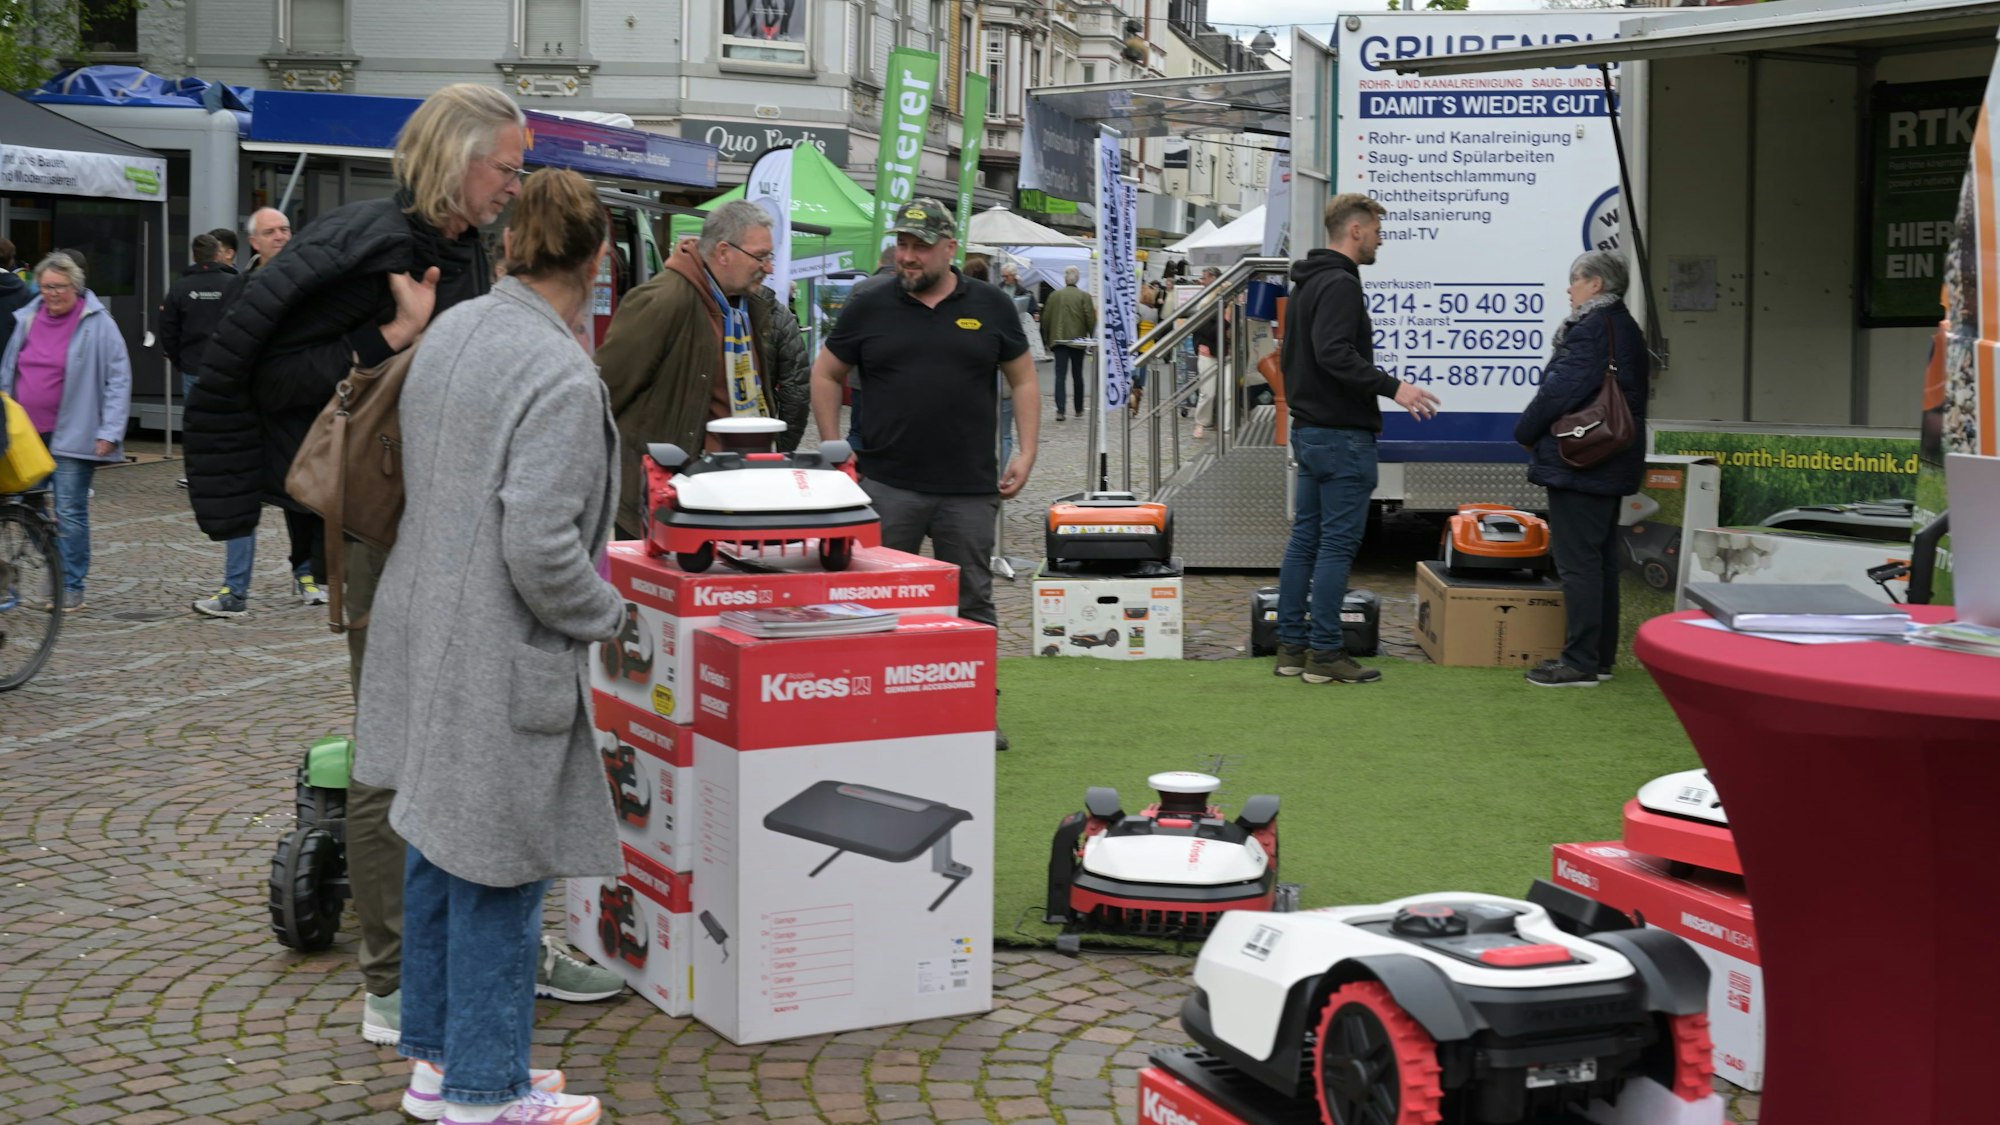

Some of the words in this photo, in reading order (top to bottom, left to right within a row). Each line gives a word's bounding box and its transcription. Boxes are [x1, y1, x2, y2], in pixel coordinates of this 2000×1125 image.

[1360, 79, 1394, 89] ROHR-
[1397, 79, 1420, 89] UND
[1424, 77, 1523, 89] KANALREINIGUNG
[1531, 77, 1566, 88] SAUG-
[1569, 77, 1593, 88] UND
[1461, 94, 1547, 115] WIEDER
[1552, 93, 1600, 114] GUT
[705, 126, 758, 158] Quo
[1368, 131, 1411, 144] Rohr-
[1416, 131, 1445, 144] und
[1450, 129, 1571, 146] Kanalreinigung
[1368, 150, 1413, 166] Saug-
[1418, 150, 1447, 163] und
[1452, 150, 1555, 164] Spülarbeiten
[1368, 169, 1536, 185] Teichentschlammung
[1367, 189, 1510, 205] Dichtheitsprüfung
[1378, 207, 1492, 224] analsanierung
[1378, 227, 1439, 240] anal-TV
[1888, 220, 1955, 247] HIER
[1886, 253, 1934, 278] EIN
[1362, 279, 1431, 289] everkusen
[1439, 293, 1468, 314] 50
[1476, 293, 1506, 314] 40
[1514, 293, 1544, 314] 30
[1407, 315, 1450, 327] Kaarst
[1372, 329, 1543, 350] 2131-766290
[1650, 474, 1678, 484] STIHL
[694, 586, 758, 606] Kress
[1528, 598, 1561, 607] STIHL
[884, 661, 977, 686] MISSION
[761, 673, 851, 703] Kress
[1189, 839, 1206, 864] Kress
[1557, 858, 1591, 888] Kress
